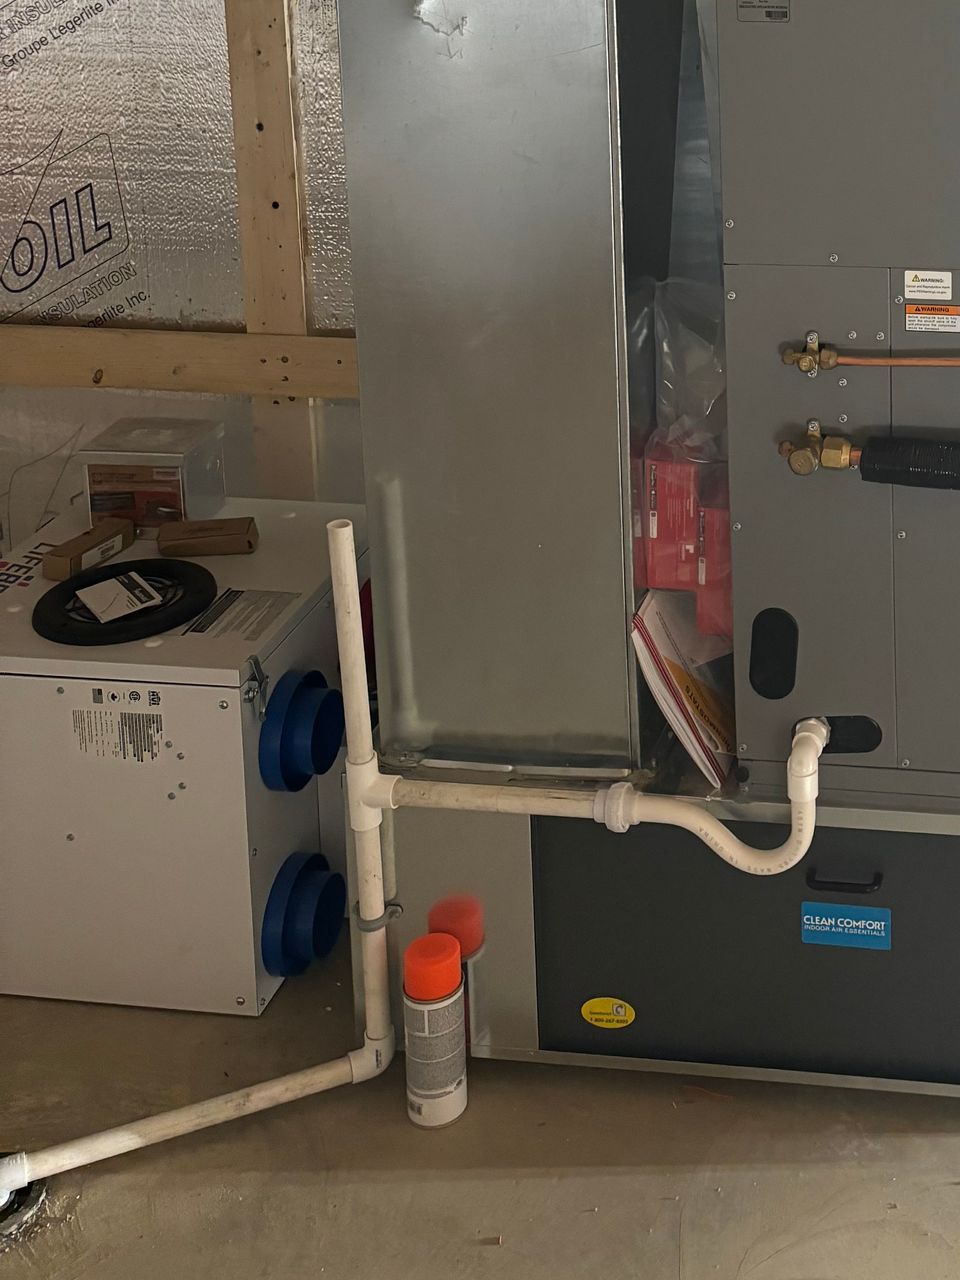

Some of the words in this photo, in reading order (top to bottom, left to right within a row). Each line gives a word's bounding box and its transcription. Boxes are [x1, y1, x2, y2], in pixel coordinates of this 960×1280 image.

[2, 35, 49, 68] Groupe
[48, 1, 104, 40] Legerlite
[125, 290, 151, 308] Inc.
[803, 915, 835, 926] CLEAN
[837, 918, 886, 930] COMFORT
[844, 928, 886, 936] ESSENTIALS
